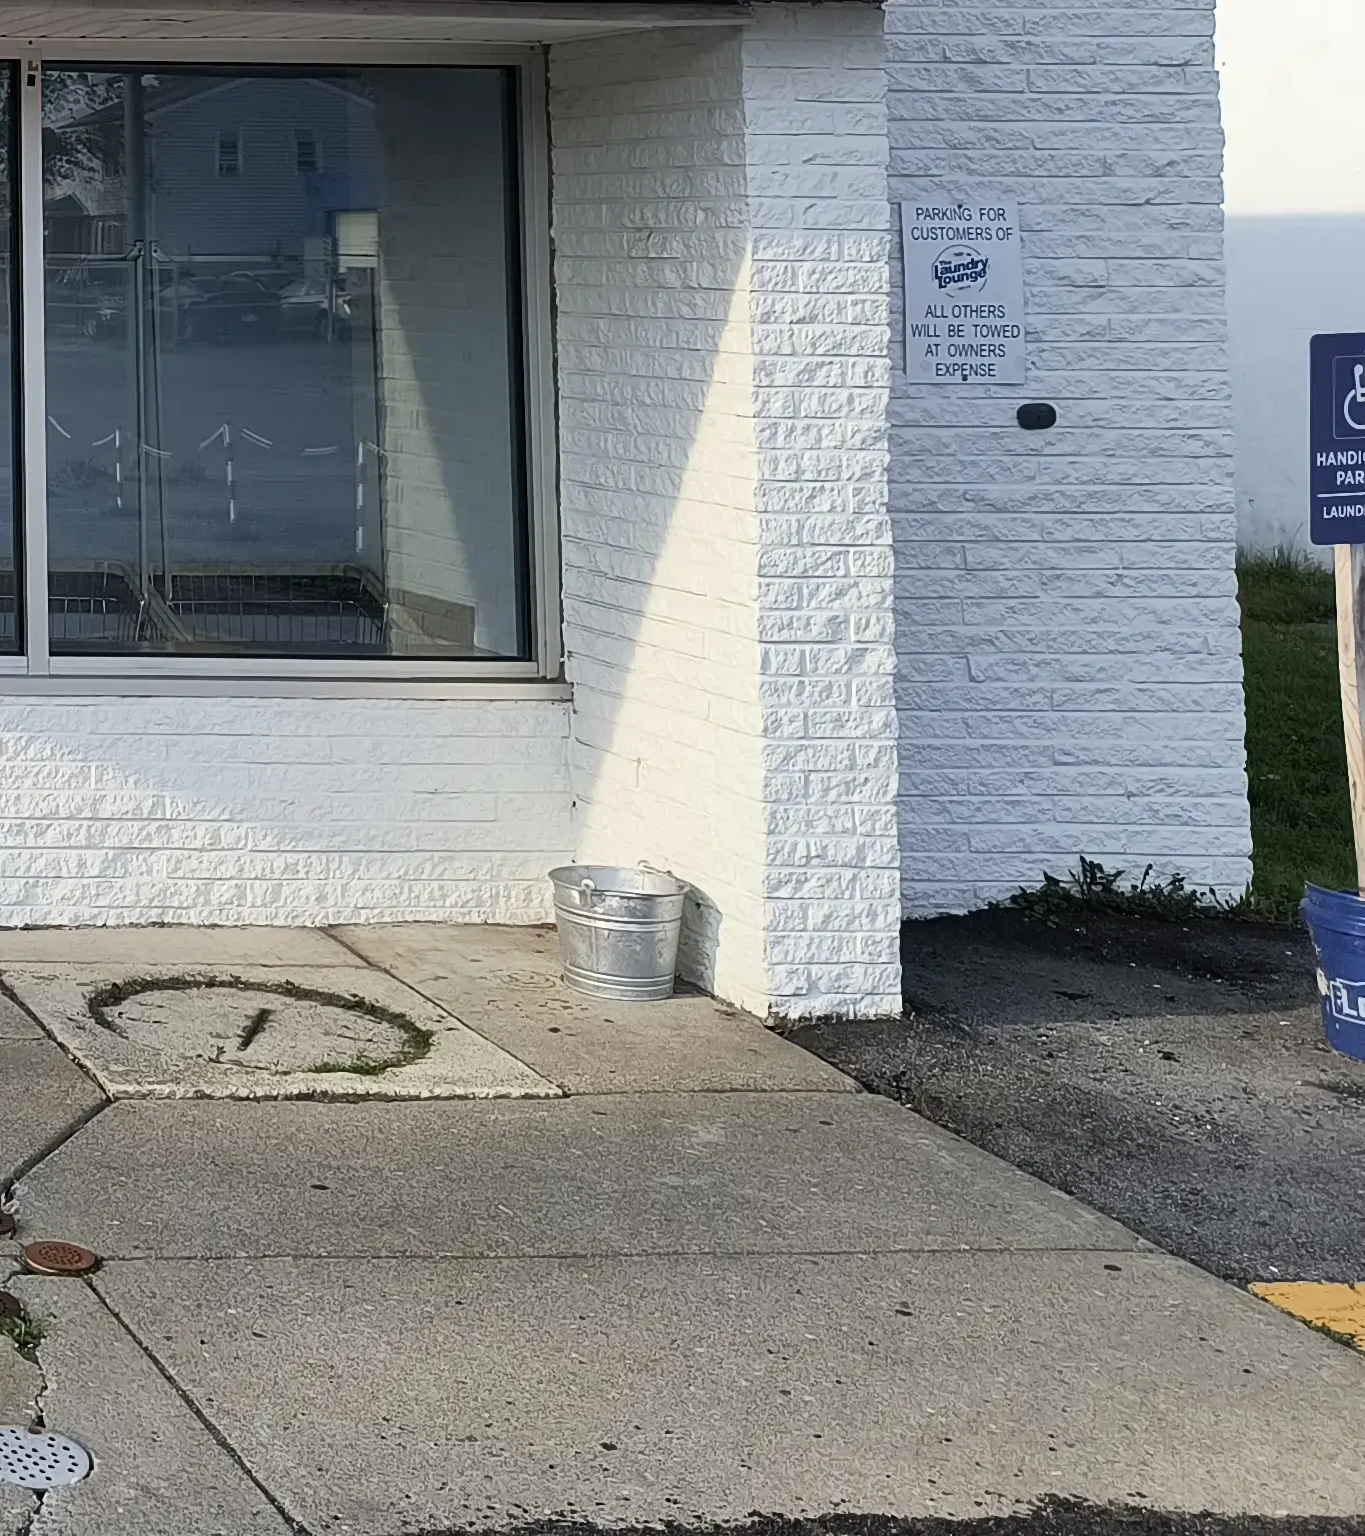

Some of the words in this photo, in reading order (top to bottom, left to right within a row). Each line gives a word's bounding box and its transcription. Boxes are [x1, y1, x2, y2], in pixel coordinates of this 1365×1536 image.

[915, 207, 972, 221] PARKING
[979, 207, 1007, 221] FOR
[910, 226, 993, 241] CUSTOMERS
[995, 227, 1014, 241] OF
[934, 257, 989, 280] Laundry
[938, 268, 988, 289] Lounge
[925, 304, 948, 319] ALL
[951, 304, 1006, 319] OTHERS
[910, 323, 941, 338] WILL
[947, 323, 966, 338] BE
[972, 324, 1021, 338] TOWED
[924, 343, 941, 357] AT
[947, 343, 1006, 358] OWNERS
[935, 363, 997, 377] EXPENSE
[1316, 450, 1365, 467] HANDI
